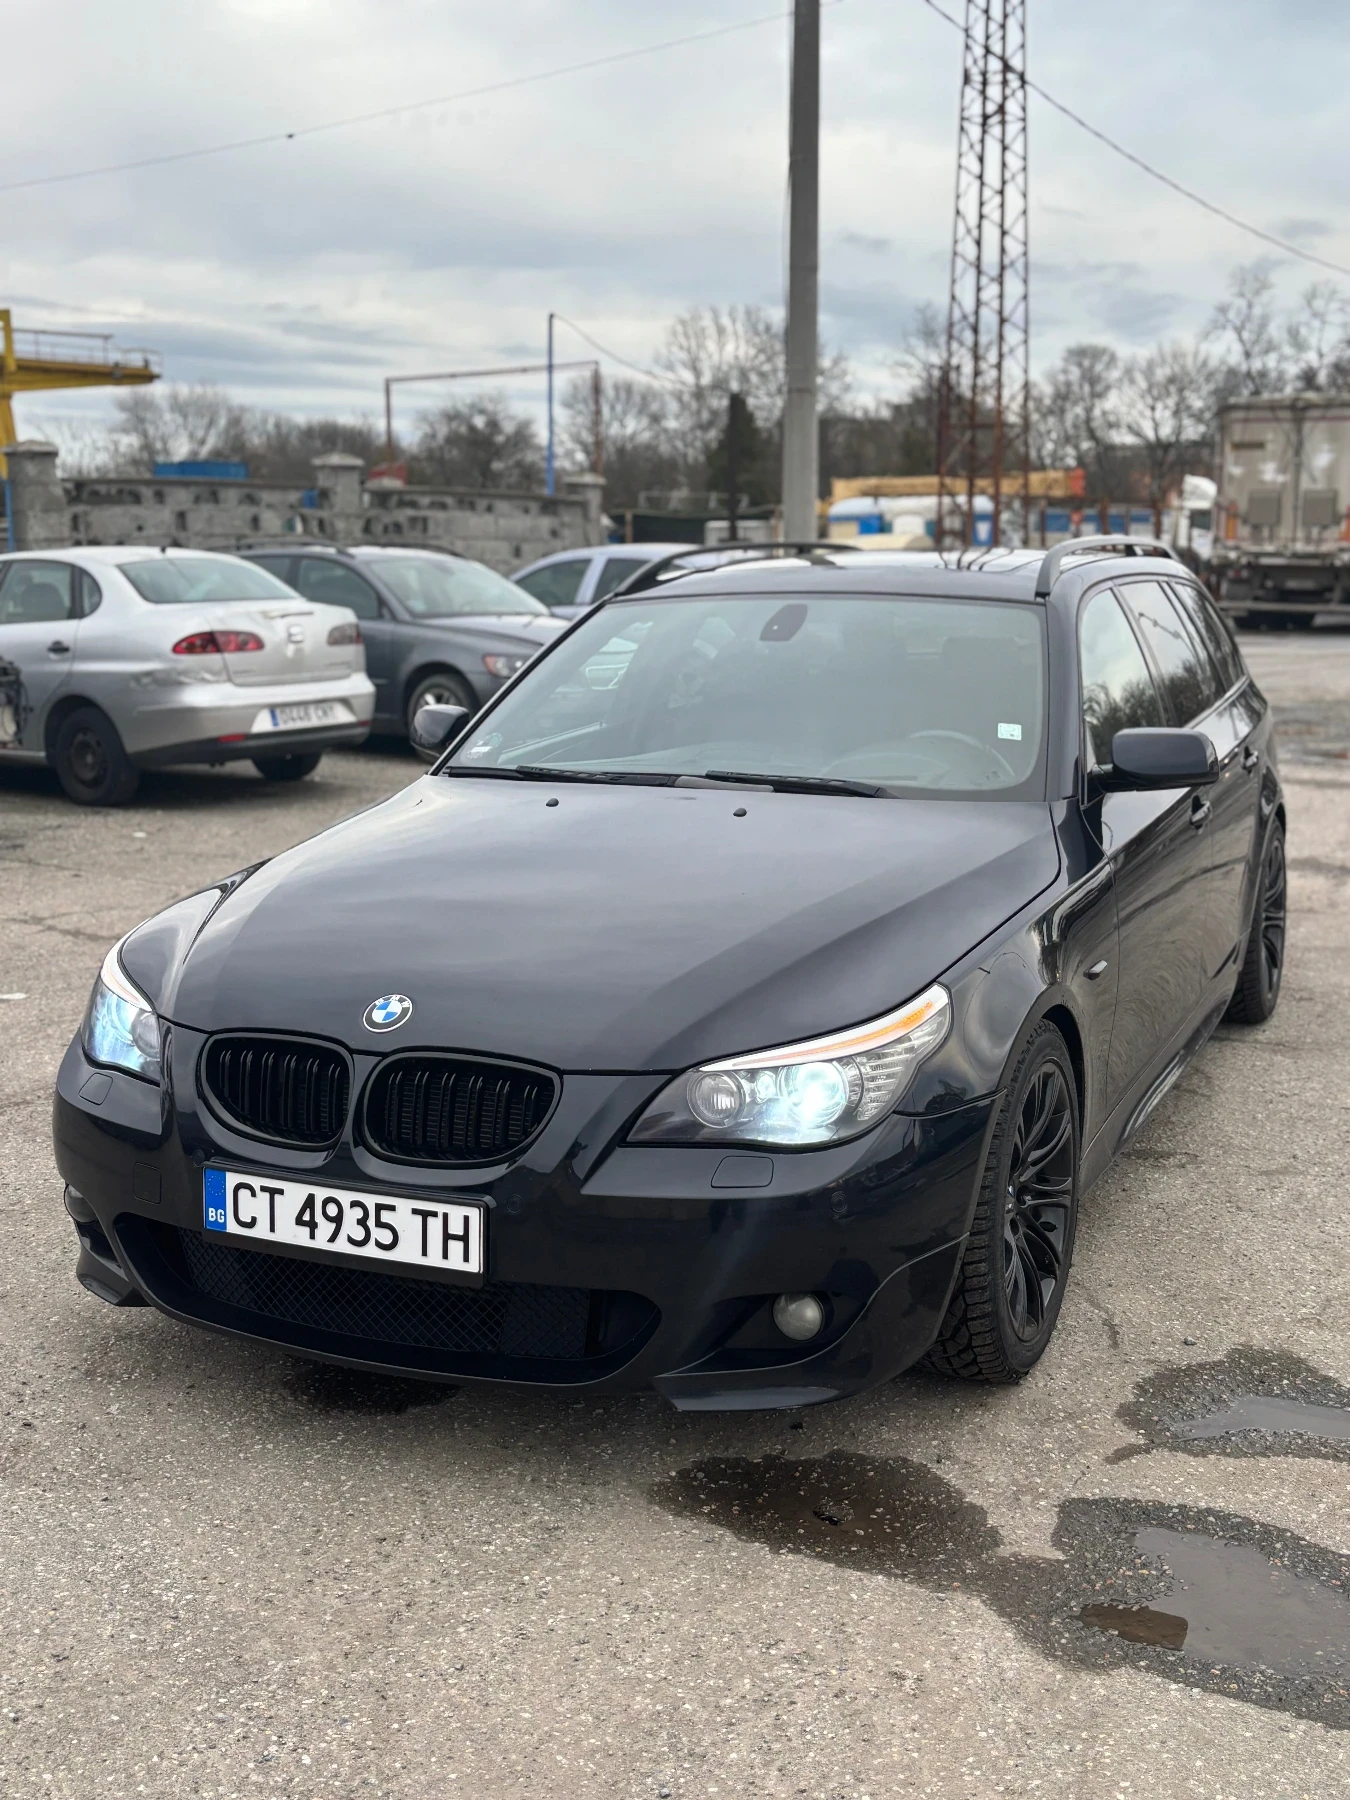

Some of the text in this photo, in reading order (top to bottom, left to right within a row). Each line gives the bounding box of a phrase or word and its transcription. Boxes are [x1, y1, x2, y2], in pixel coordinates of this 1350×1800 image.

[208, 1207, 225, 1223] BG
[232, 1181, 470, 1263] CT 4935 TH
